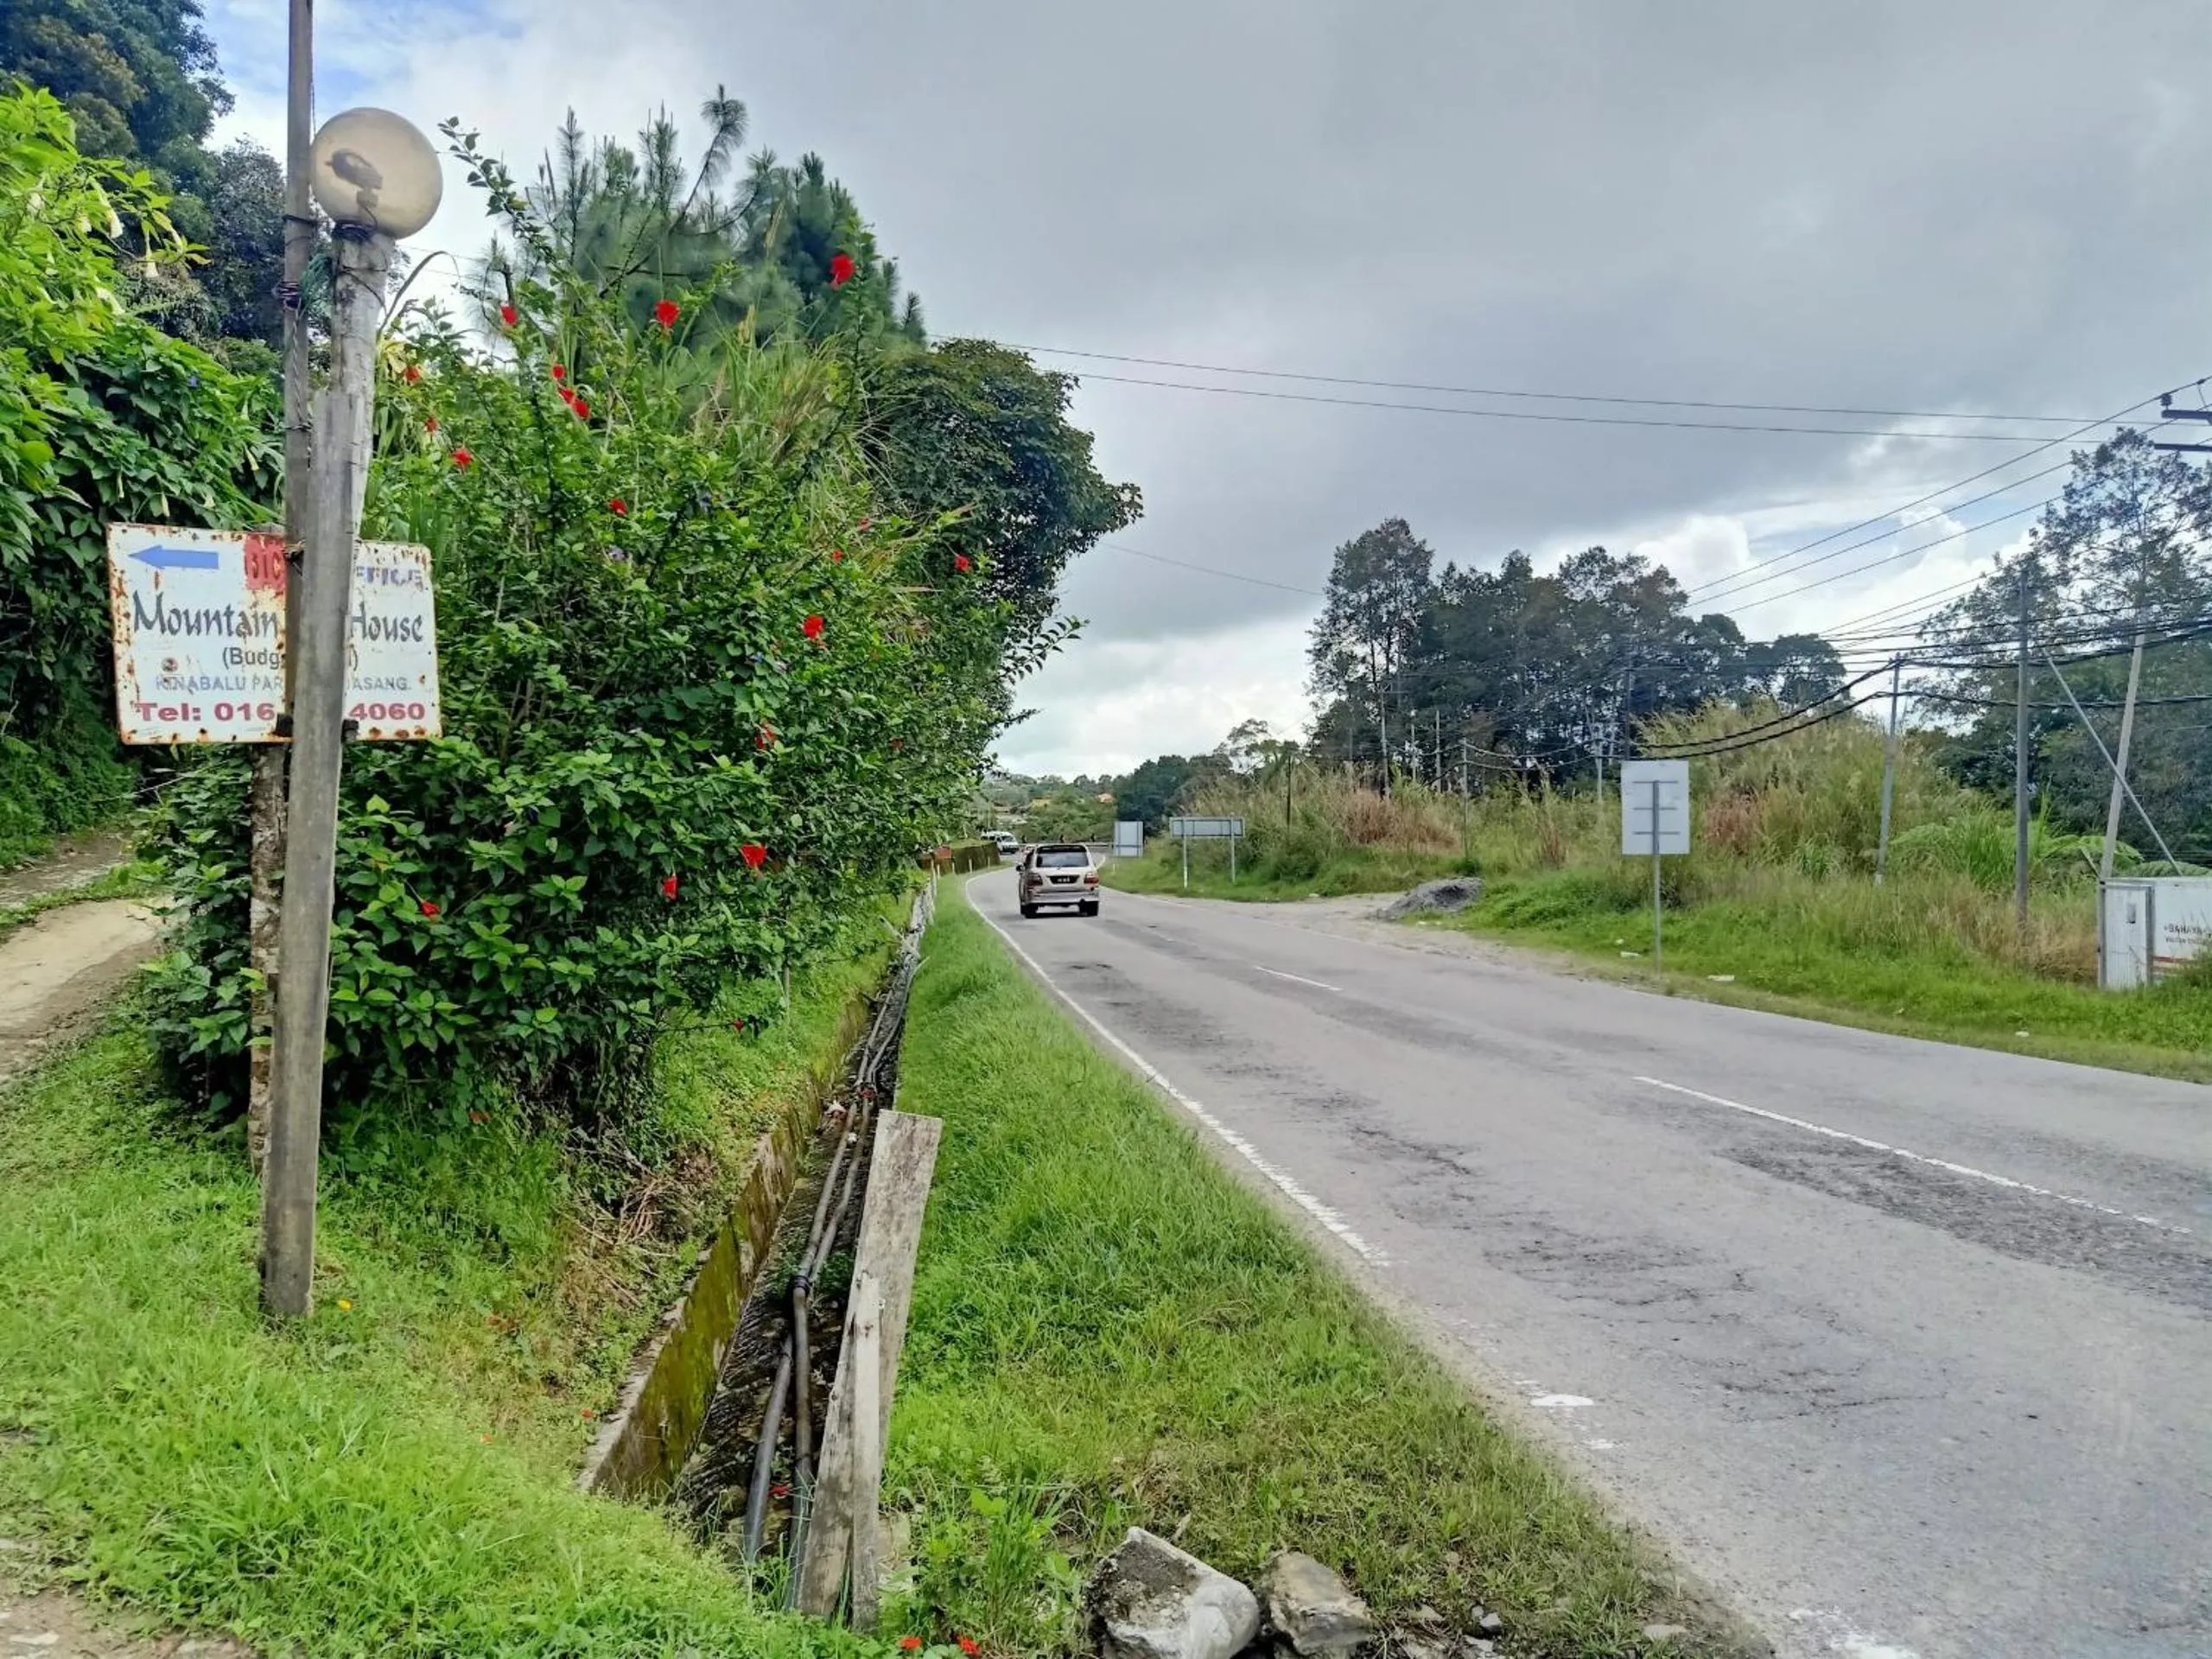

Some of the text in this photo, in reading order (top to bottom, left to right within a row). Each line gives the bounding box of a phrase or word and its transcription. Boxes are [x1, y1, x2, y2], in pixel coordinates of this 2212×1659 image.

[132, 589, 423, 642] Mountain House
[222, 647, 281, 670] (Budg
[252, 675, 283, 691] PAR
[135, 702, 201, 721] Tel:
[348, 702, 425, 721] 4060
